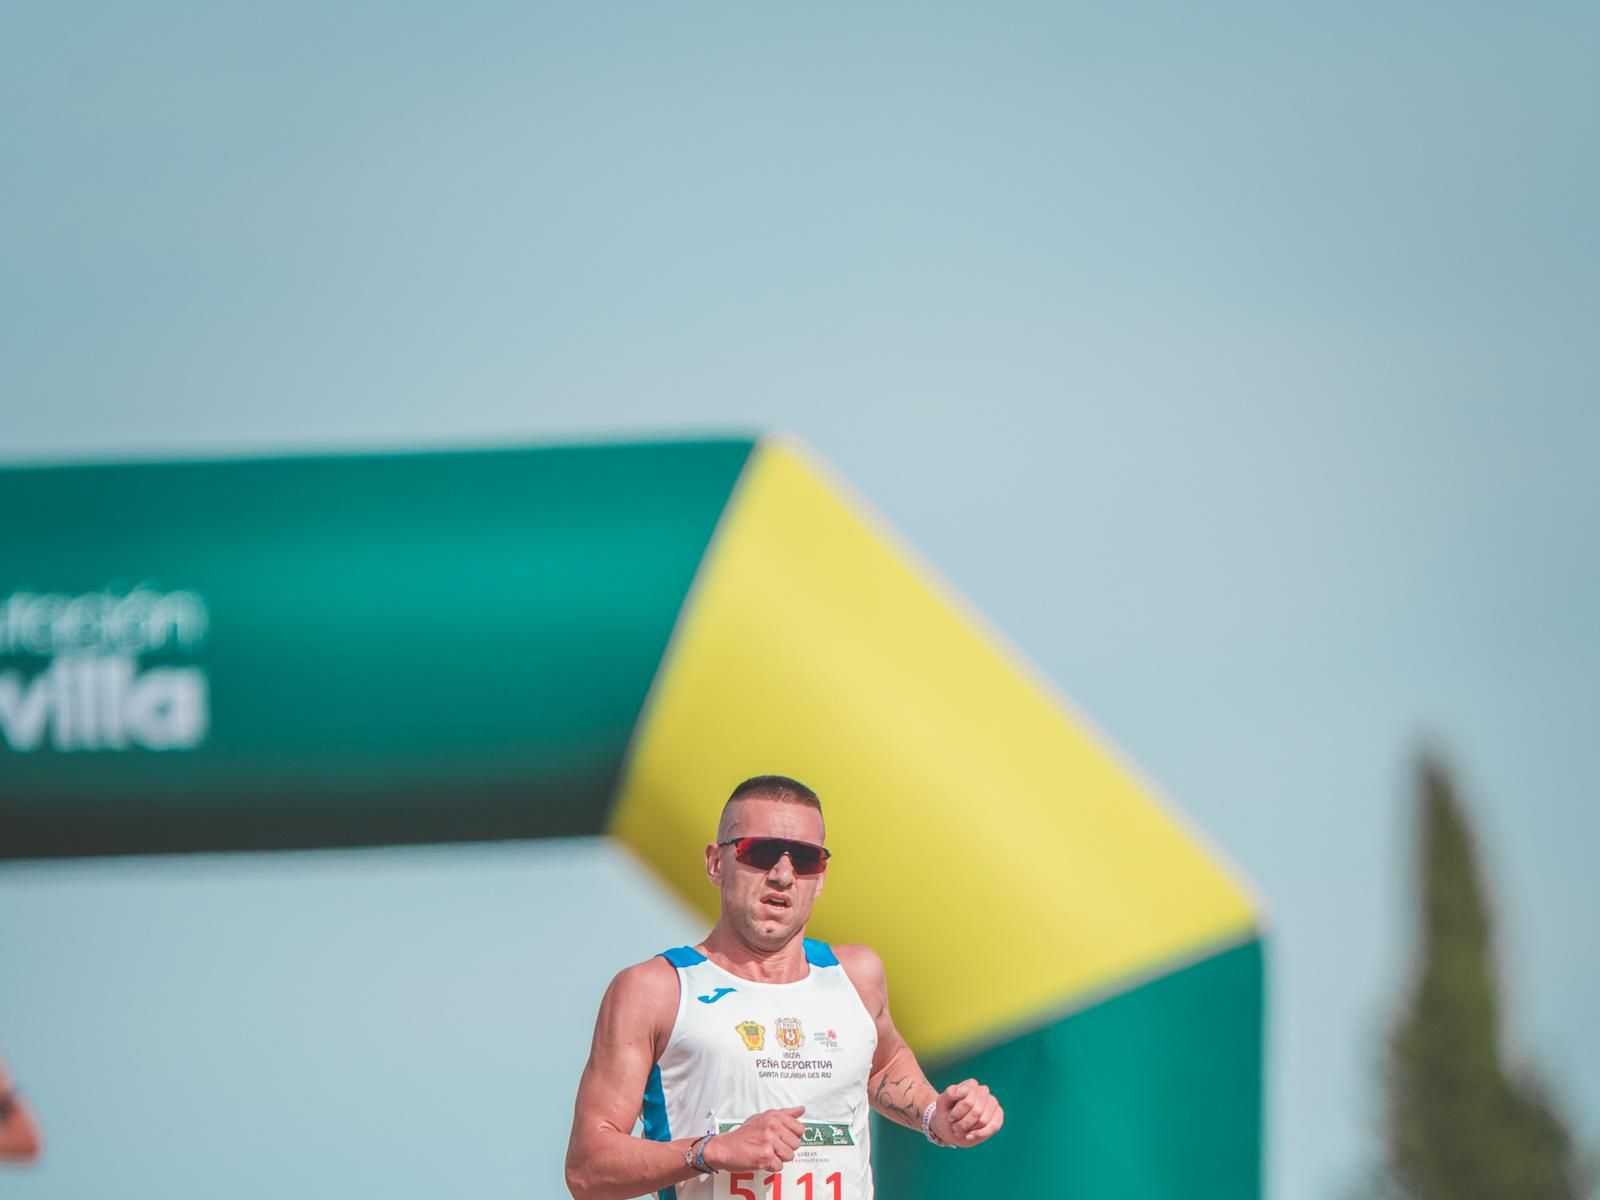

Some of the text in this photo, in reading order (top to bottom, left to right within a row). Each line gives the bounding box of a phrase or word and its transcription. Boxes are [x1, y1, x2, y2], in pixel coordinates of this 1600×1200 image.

[0, 584, 208, 653] tación
[0, 653, 209, 752] villa
[756, 1058, 833, 1070] PEÑA DEPORTIVA
